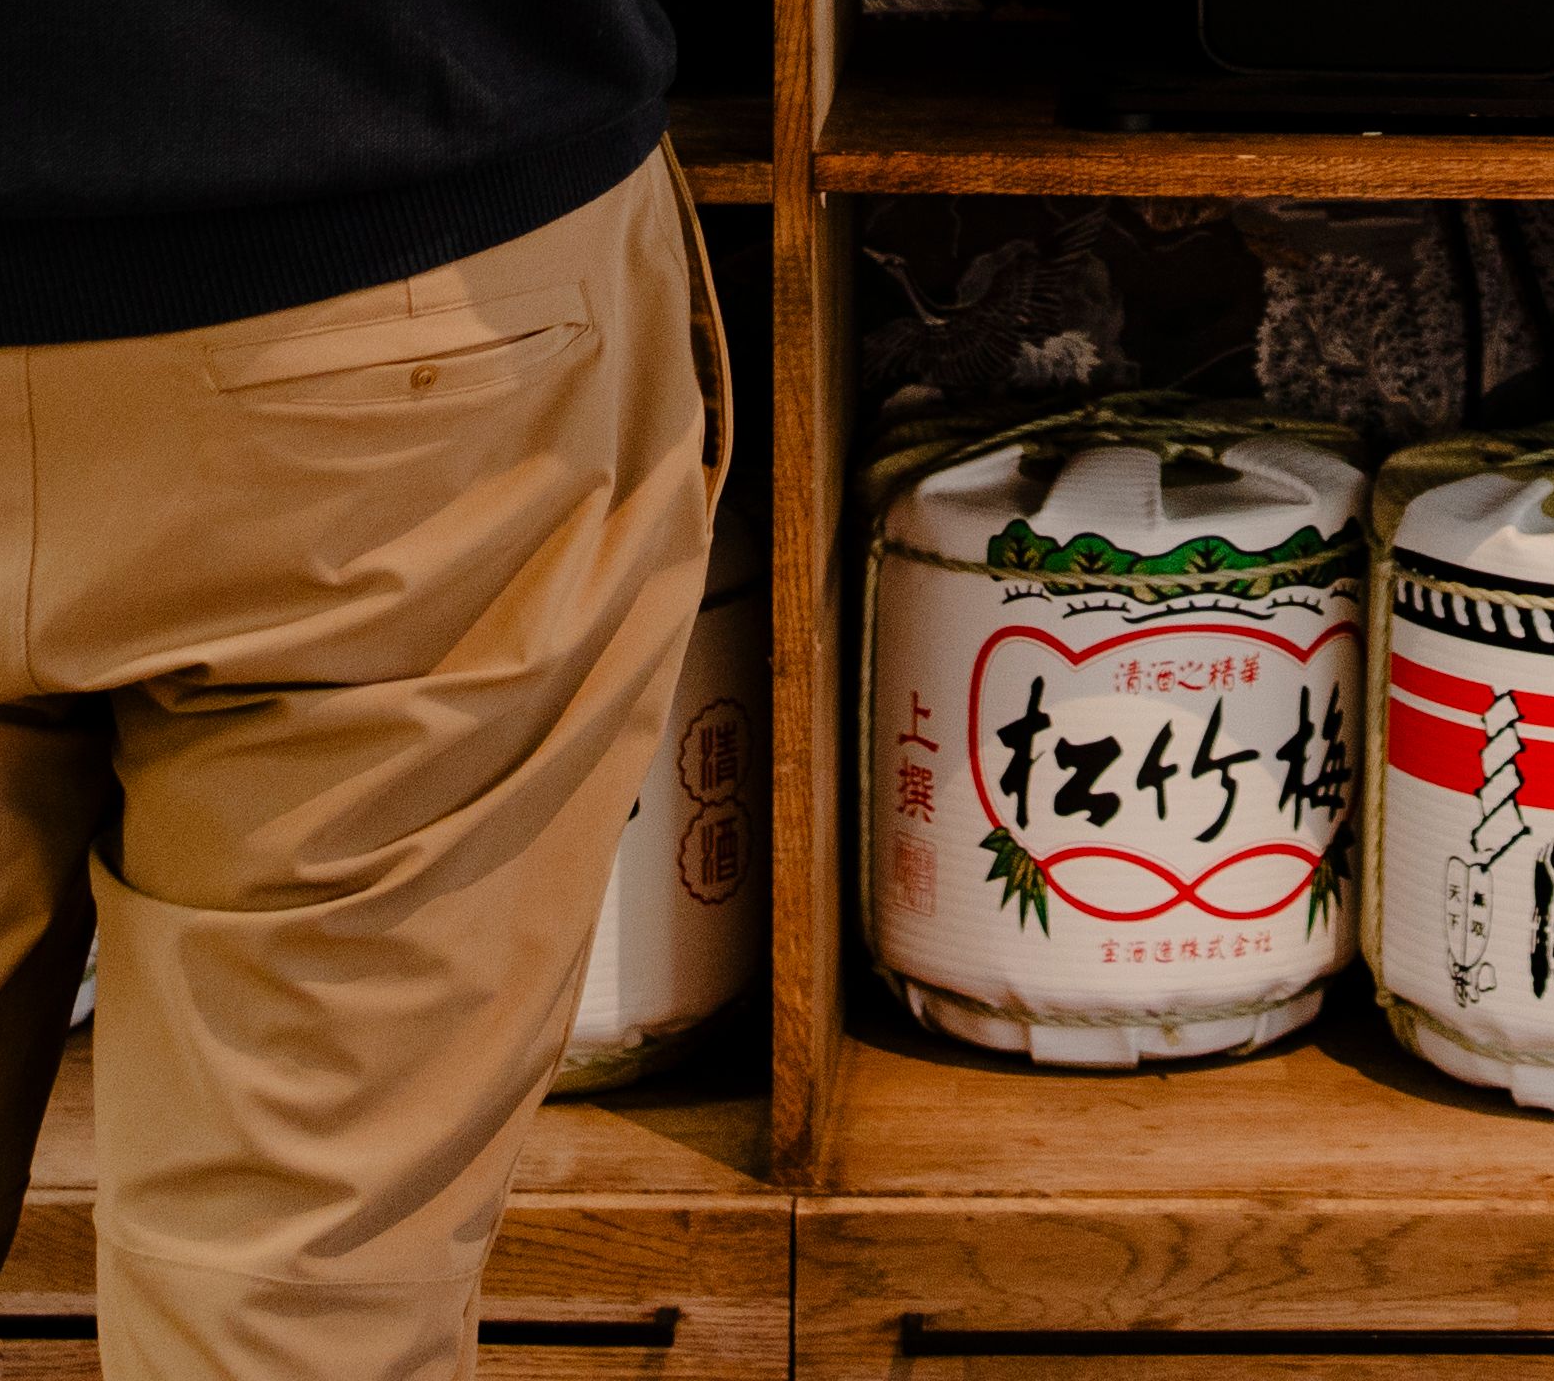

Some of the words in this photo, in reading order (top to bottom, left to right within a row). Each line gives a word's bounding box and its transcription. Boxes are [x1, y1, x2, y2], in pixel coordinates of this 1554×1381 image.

[1114, 652, 1261, 696] 清酒之精華
[996, 675, 1353, 843] 松竹梅
